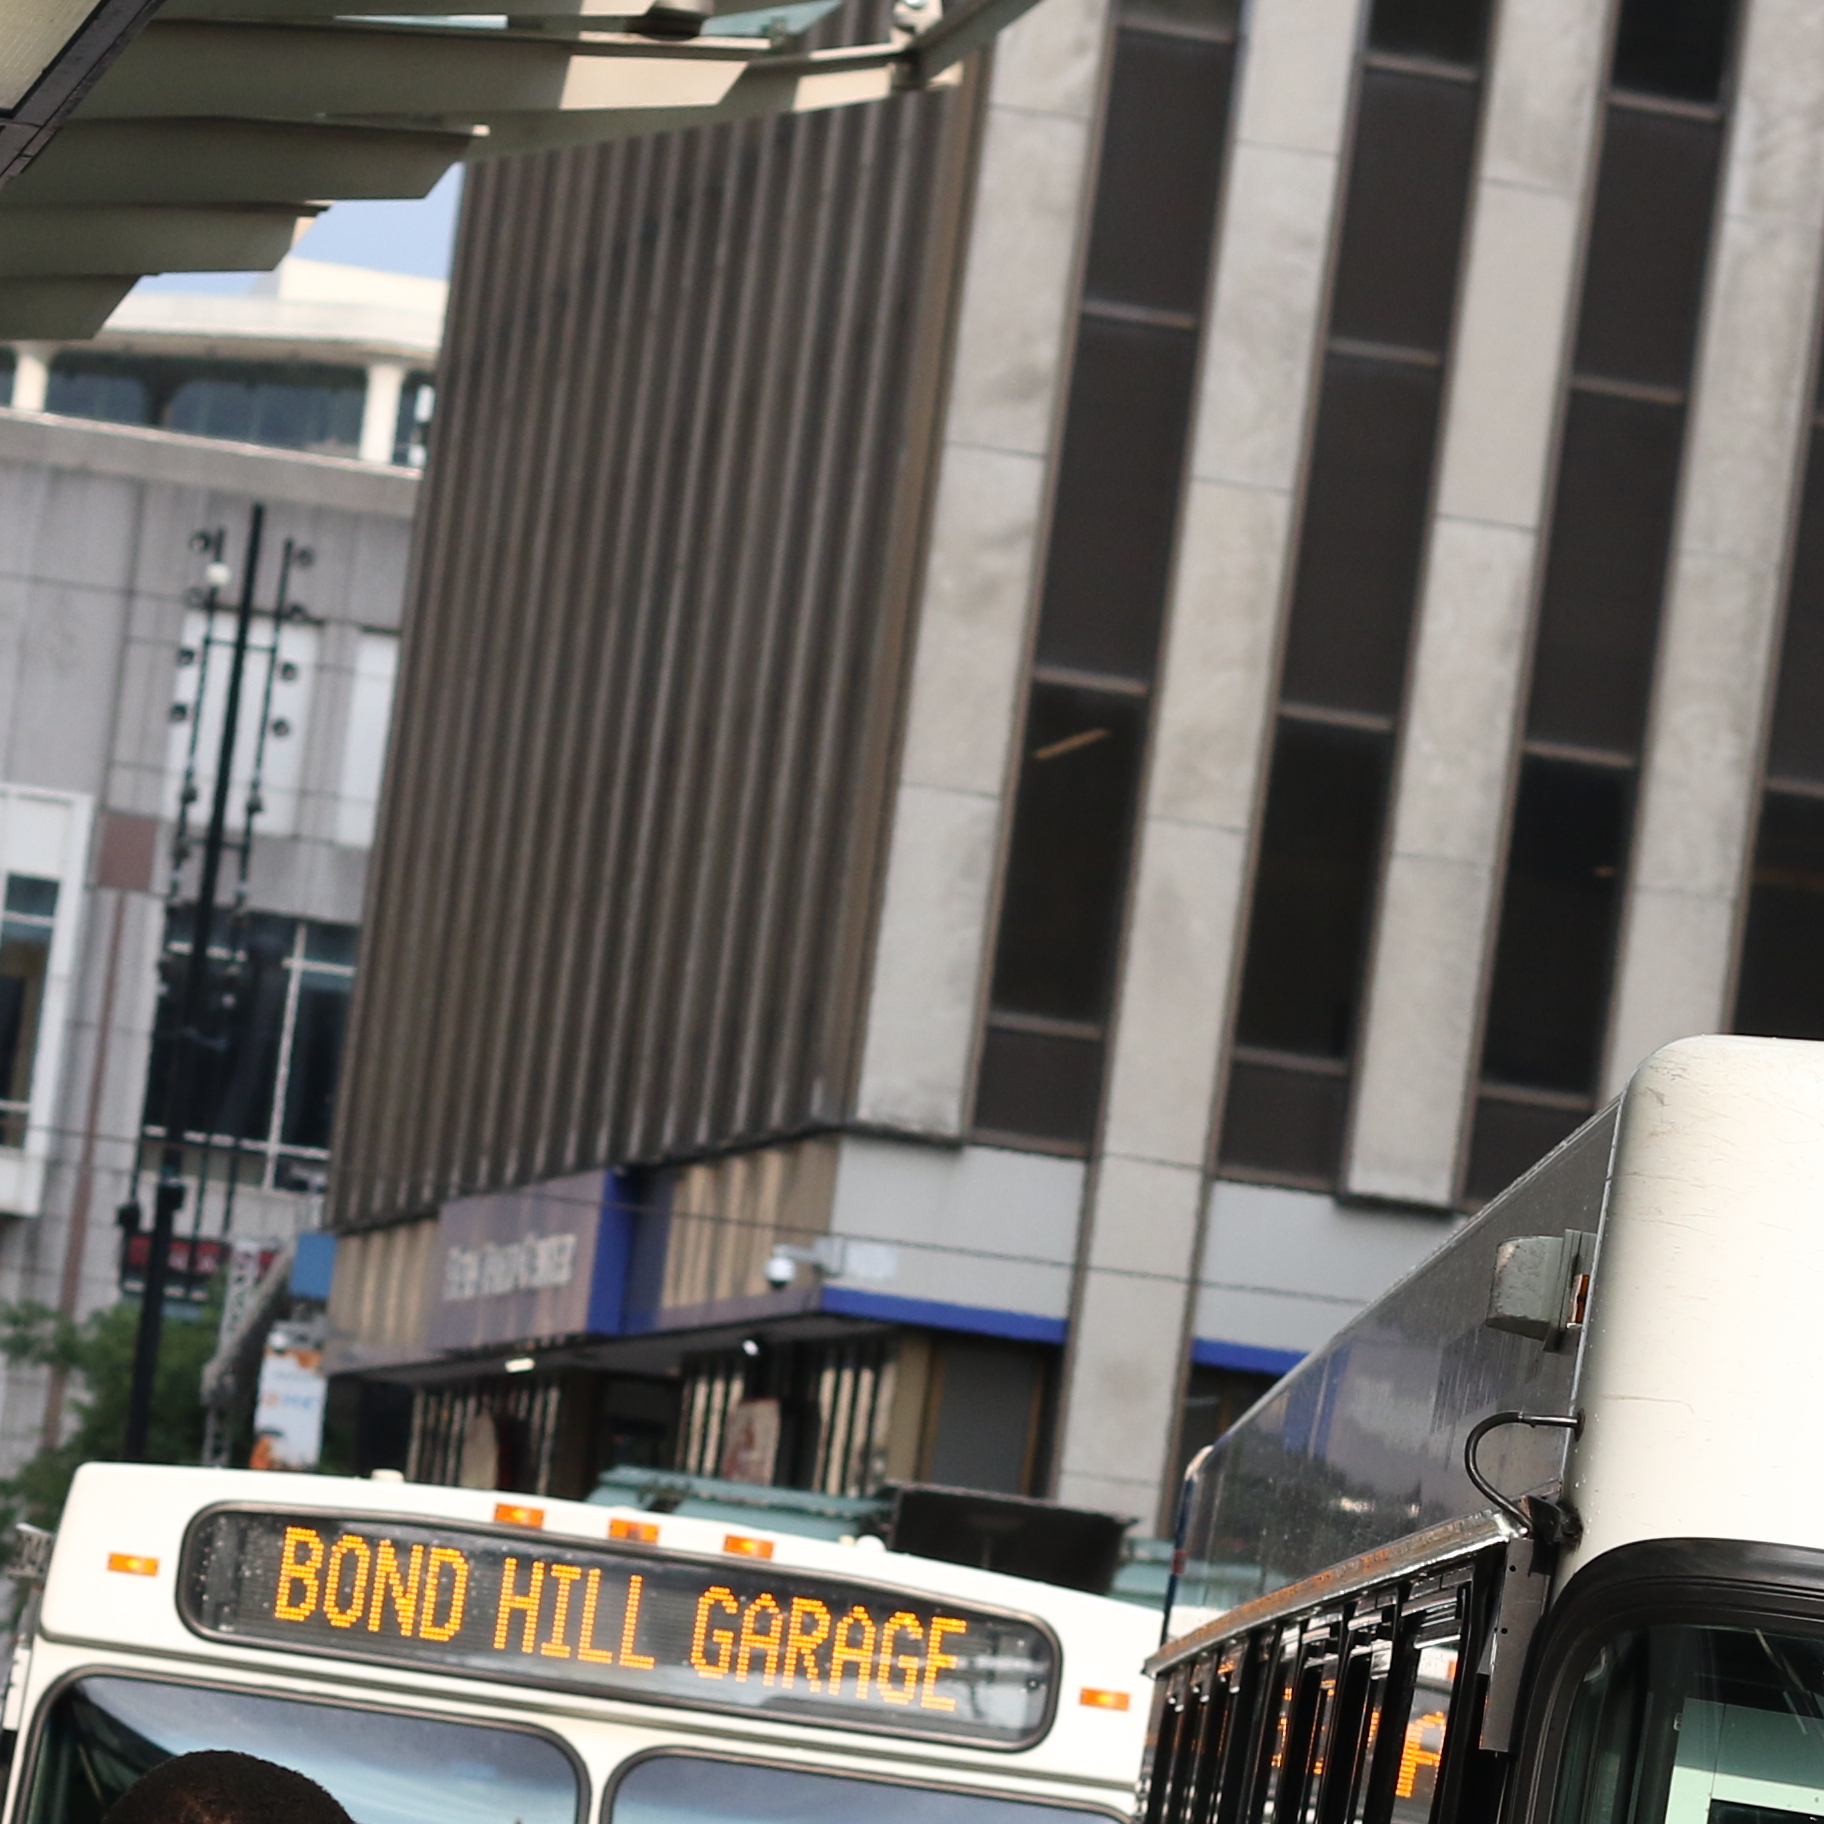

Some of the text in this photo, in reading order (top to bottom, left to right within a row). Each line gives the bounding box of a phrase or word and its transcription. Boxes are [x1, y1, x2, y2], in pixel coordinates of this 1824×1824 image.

[275, 1526, 968, 1712] BOND HILL GARAGE
